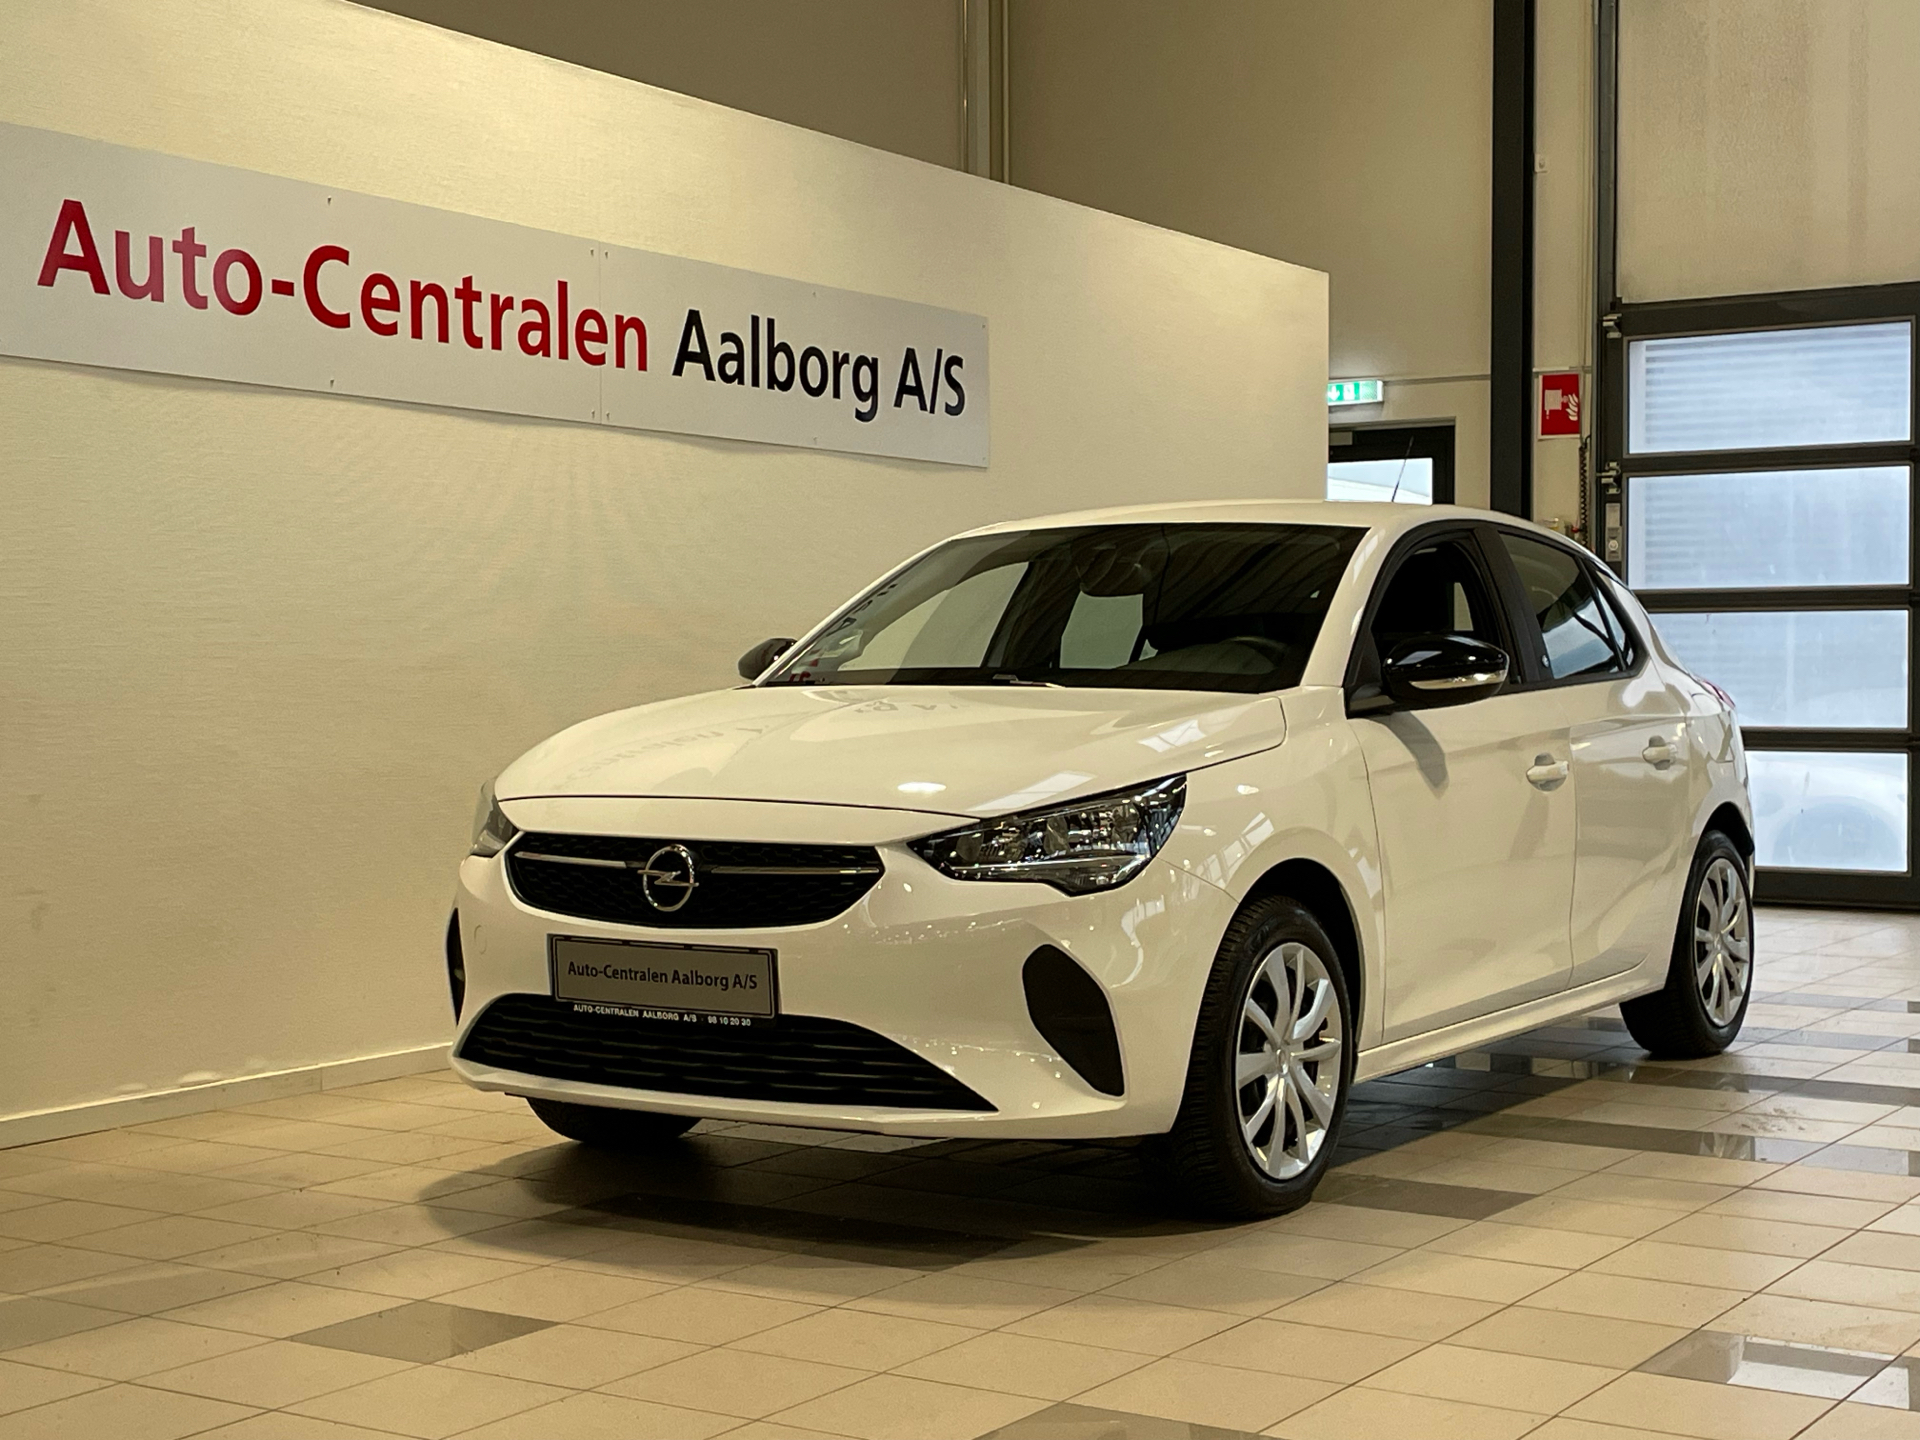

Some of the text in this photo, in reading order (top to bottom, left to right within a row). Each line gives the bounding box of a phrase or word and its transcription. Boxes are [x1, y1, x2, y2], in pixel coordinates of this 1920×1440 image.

[37, 199, 966, 423] Auto-Centralen Aalborg A/S
[567, 961, 757, 991] Auto-Centralen Aalborg A/S
[573, 1004, 639, 1017] AUTO-CENTRALEN
[642, 1010, 679, 1021] AALBORG
[683, 1013, 697, 1022] A/S
[730, 1017, 740, 1026] 20
